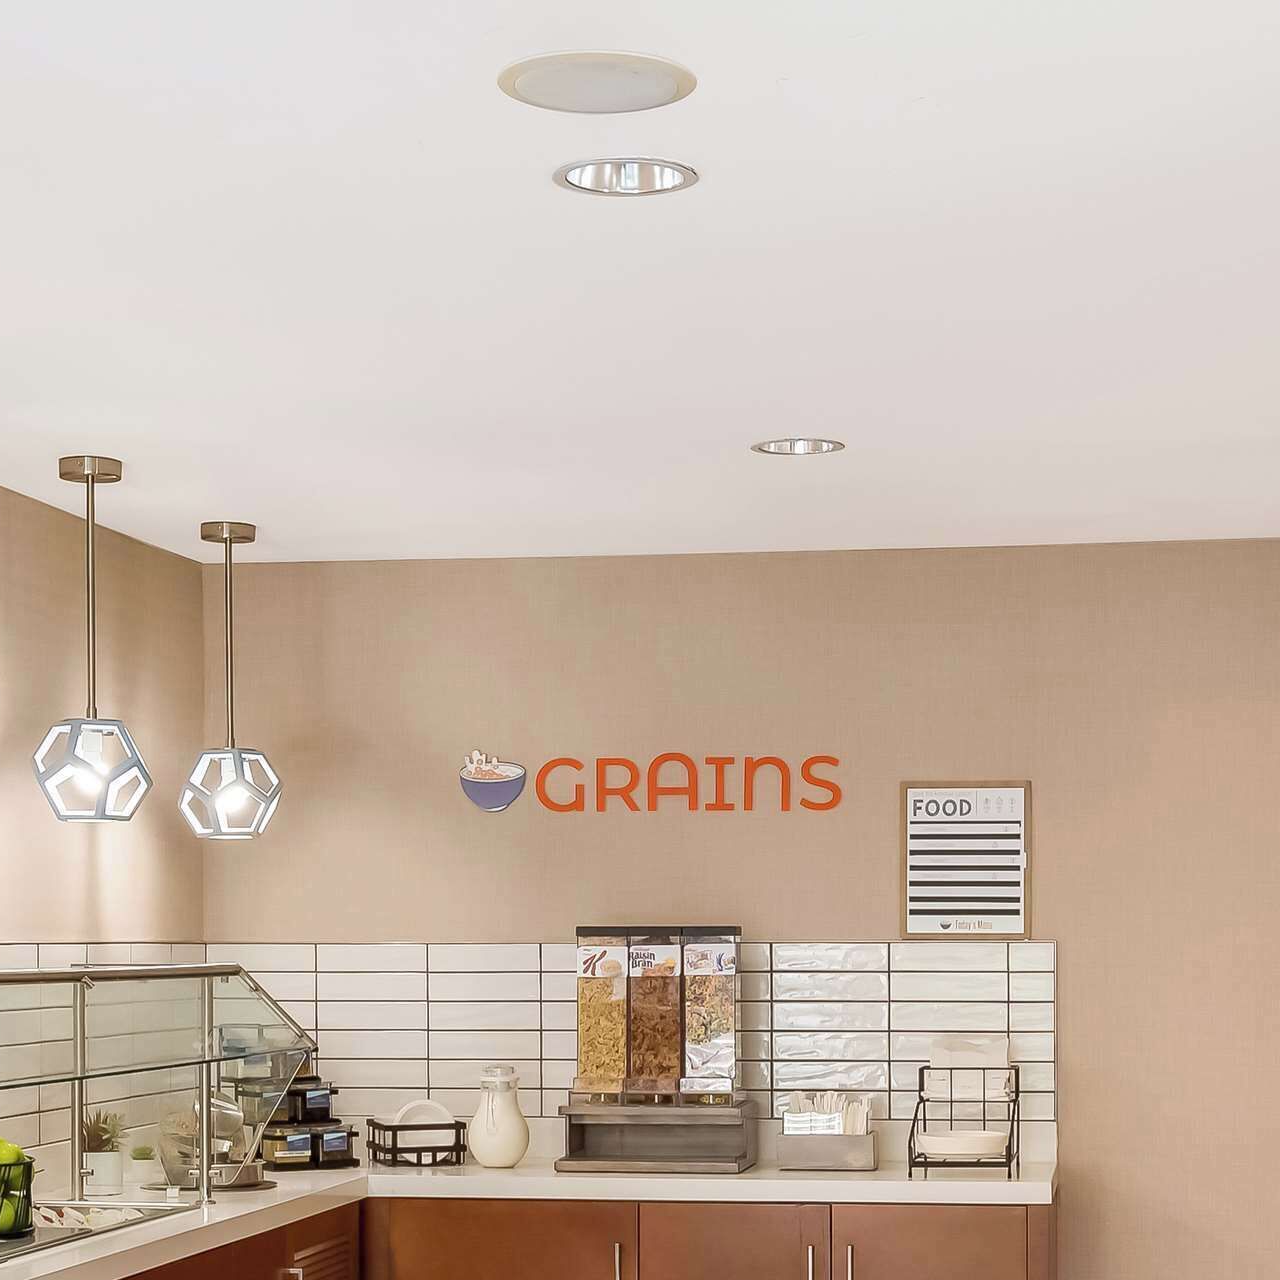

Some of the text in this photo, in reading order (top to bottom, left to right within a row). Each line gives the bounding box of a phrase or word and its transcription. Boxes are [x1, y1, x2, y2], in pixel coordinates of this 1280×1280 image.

[535, 752, 843, 812] GRAINS
[912, 799, 972, 817] FOOD
[629, 950, 656, 961] Raisin
[631, 958, 653, 969] Bran
